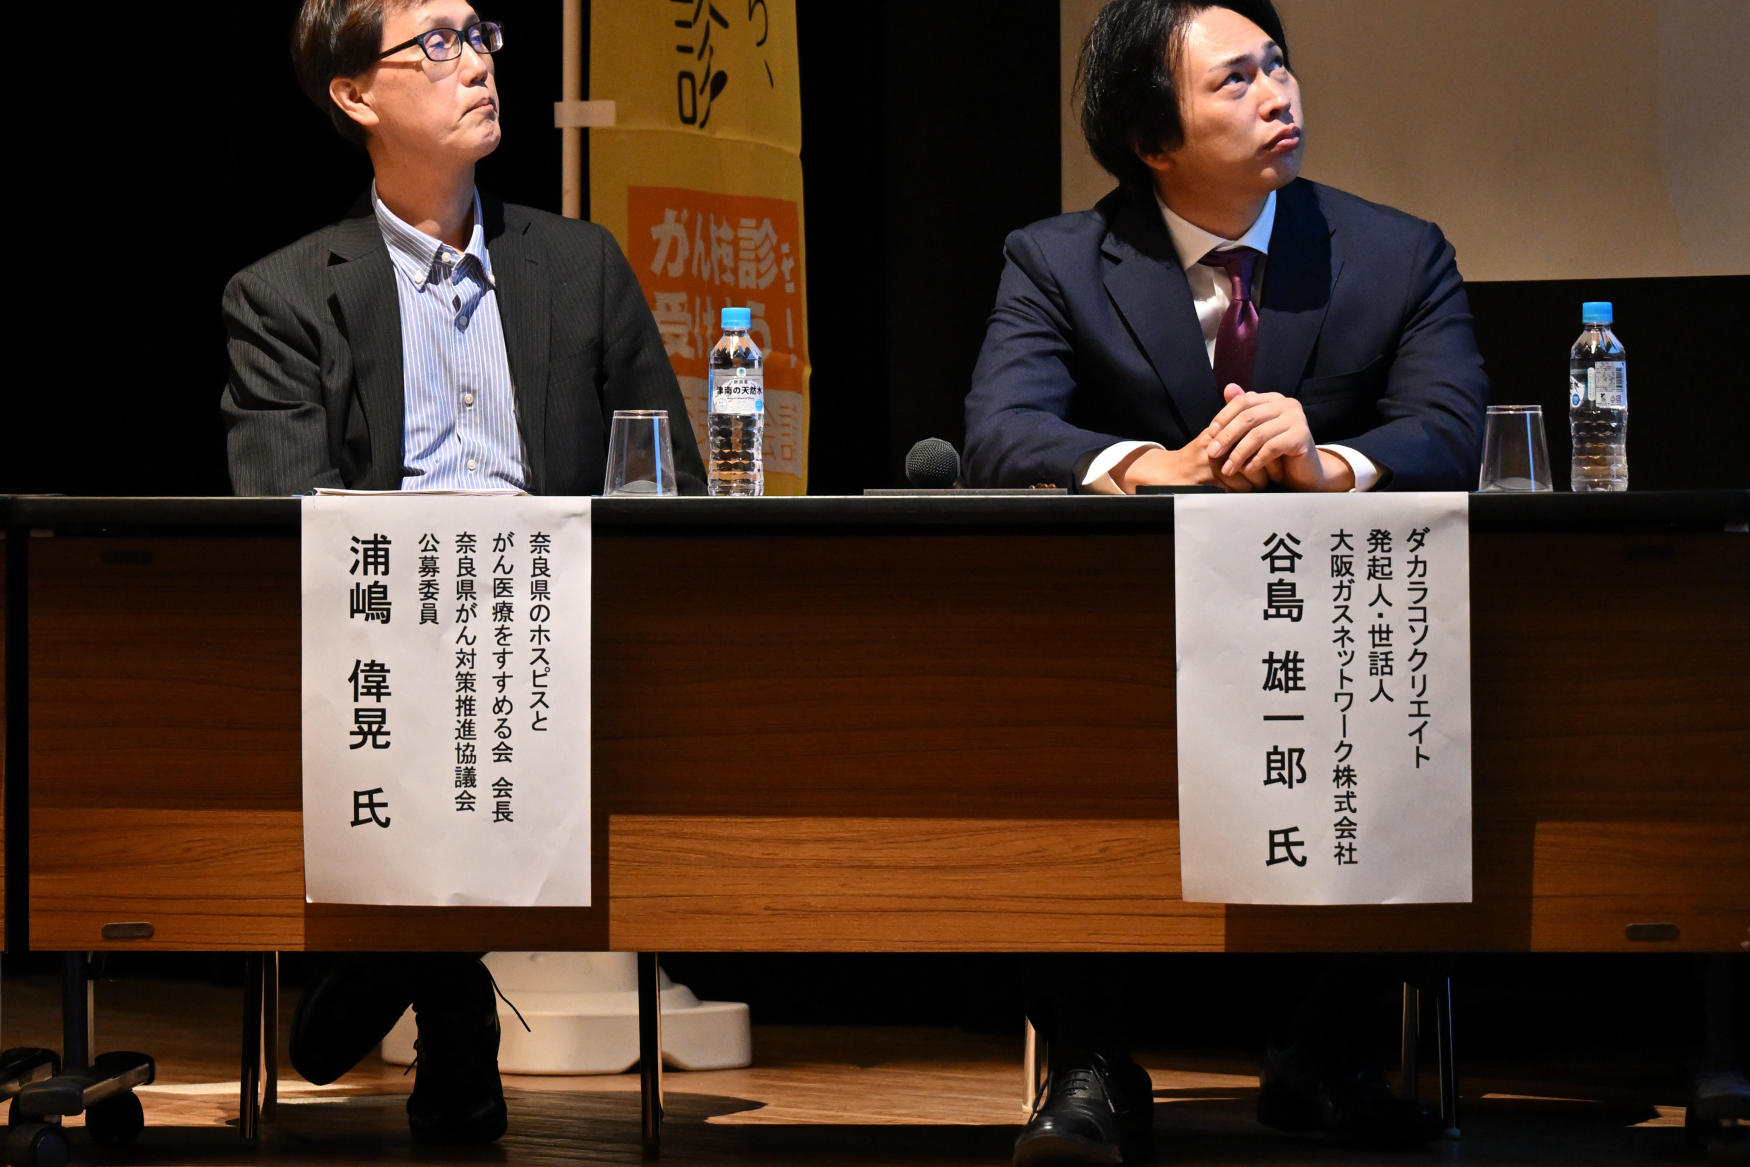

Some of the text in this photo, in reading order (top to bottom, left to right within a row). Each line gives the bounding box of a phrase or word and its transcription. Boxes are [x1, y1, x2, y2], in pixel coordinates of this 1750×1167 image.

[348, 534, 392, 828] 浦嶋 偉晃 氏
[419, 534, 440, 625] 公募委員
[455, 532, 477, 811] 奈良県がん対策推進協議会
[492, 532, 514, 823] がん医療をすすめる会 会長
[530, 532, 551, 731] 奈良県のホスピスと
[1261, 533, 1307, 867] 谷島 雄一郎 氏
[1331, 529, 1358, 865] 大阪ガスネットワーク株式会社
[1367, 529, 1394, 702] 発起人・世話人
[1406, 527, 1431, 768] ダカラコソクリエイト
